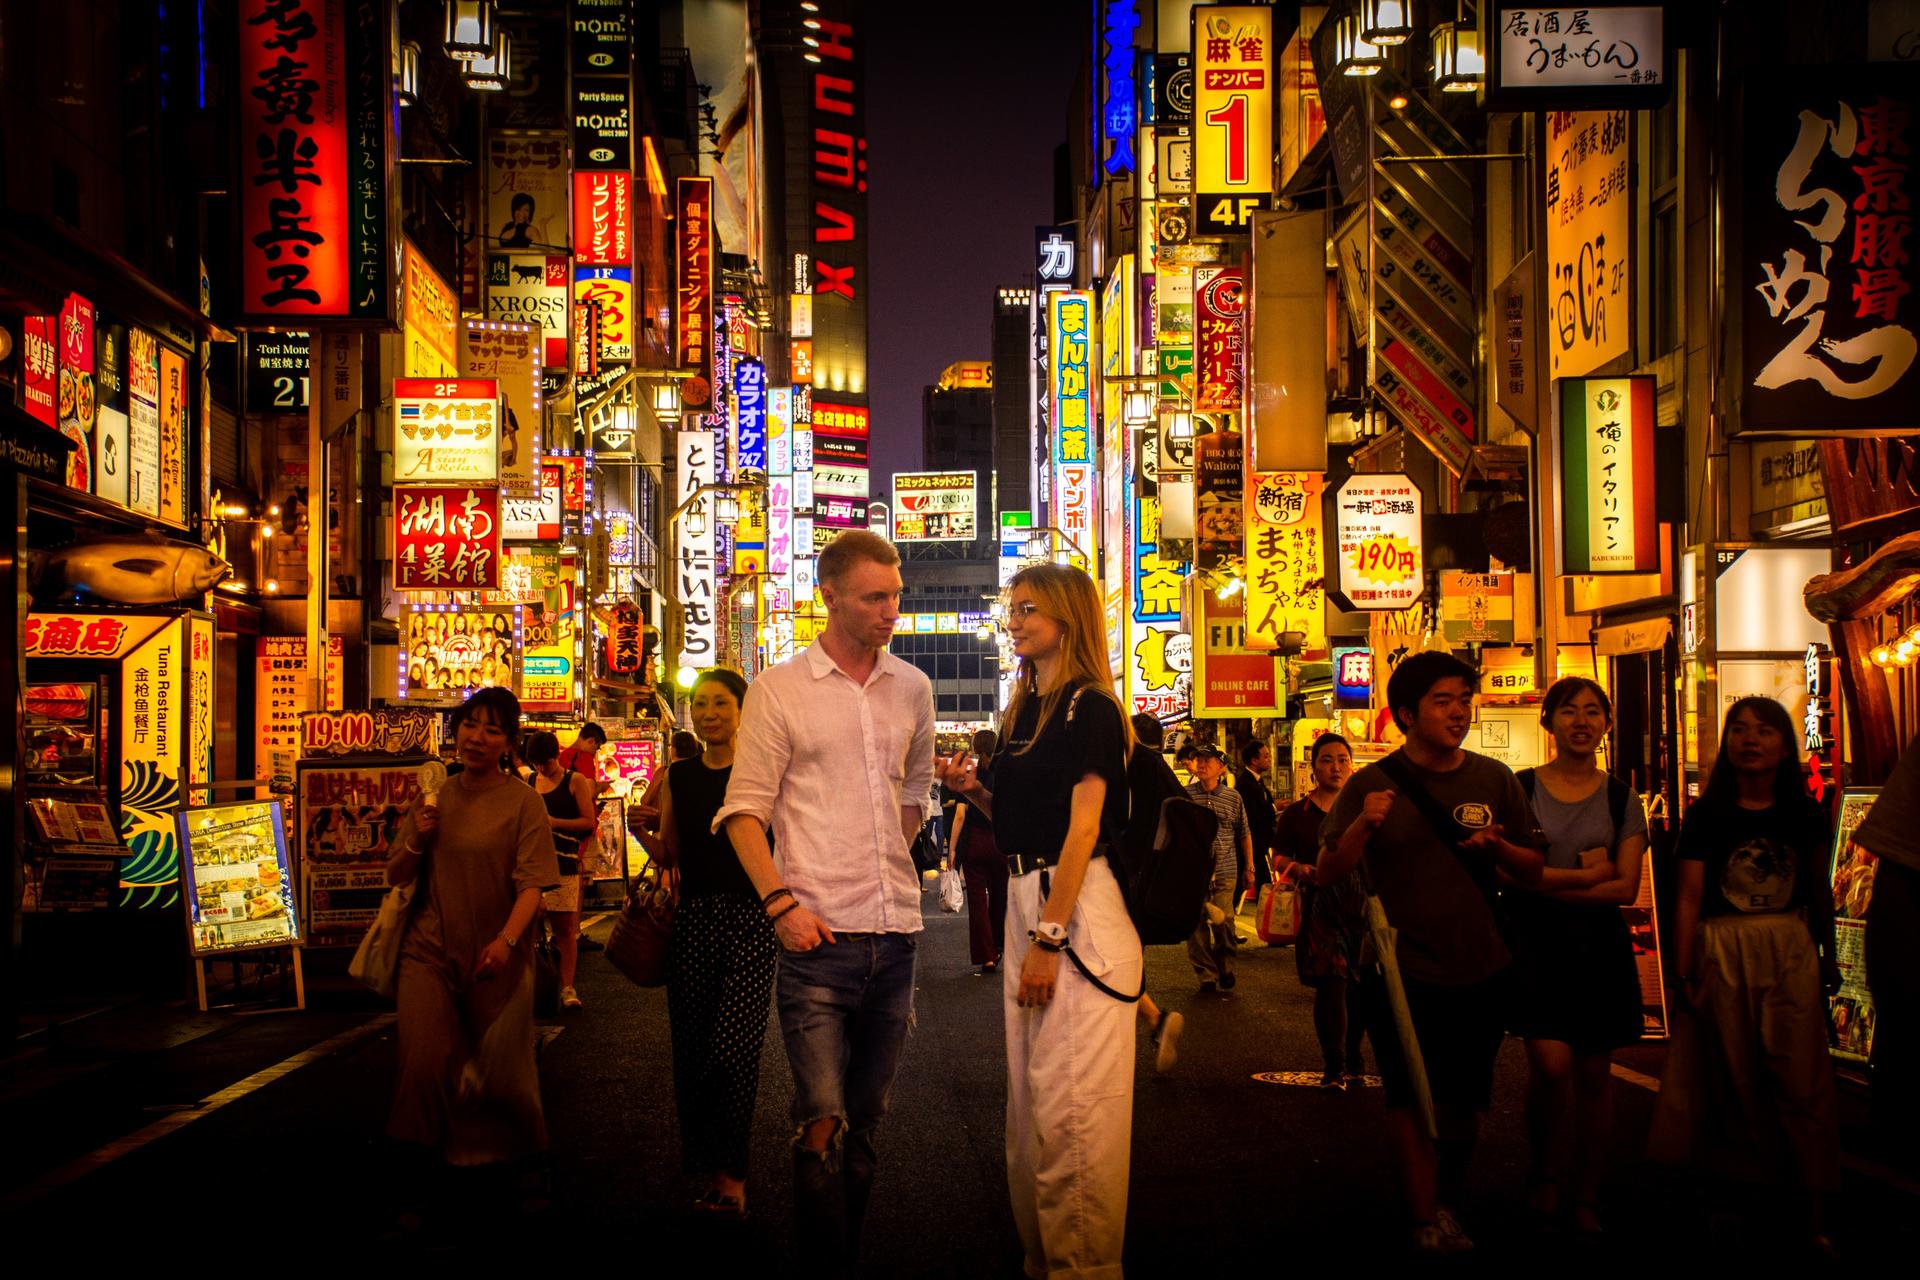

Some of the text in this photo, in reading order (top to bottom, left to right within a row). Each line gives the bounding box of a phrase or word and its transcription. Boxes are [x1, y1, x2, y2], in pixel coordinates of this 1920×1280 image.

[1503, 10, 1593, 37] 居酒屋
[1205, 37, 1264, 63] 麻雀
[1208, 72, 1262, 87] ナンバー
[1614, 69, 1658, 84] 一番街
[579, 92, 624, 102] Party Space
[1206, 94, 1249, 185] 1
[1548, 164, 1560, 215] 串
[592, 175, 610, 263] リフレッシュ
[614, 174, 626, 260] レンタルルーム ホステル
[1210, 198, 1259, 226] 4F
[1851, 96, 1914, 322] 東京豚骨
[593, 268, 614, 279] 1F
[686, 202, 703, 363] 個室ダイニング居酒屋
[1197, 270, 1214, 281] 3F
[491, 296, 565, 313] XROSS
[469, 345, 529, 359] マッサージ
[603, 345, 630, 358] 天神
[1210, 319, 1227, 398] カリーナ
[469, 362, 486, 372] 2F
[434, 384, 457, 396] 2F
[1060, 301, 1088, 461] まんが喫茶
[1377, 371, 1400, 393] B1
[422, 402, 492, 421] タイ古式
[739, 362, 761, 450] カラオケ
[812, 411, 867, 430] 全店営業中
[400, 423, 492, 441] マッサージ
[738, 452, 761, 466] 747
[803, 431, 812, 466] カラオケ
[1205, 449, 1225, 458] BBQ
[436, 463, 481, 473] Relax
[1595, 420, 1622, 550] 俺のイタリアン
[1065, 468, 1085, 550] マンボー
[1258, 485, 1304, 512] 新宿
[1342, 499, 1415, 515] 一軒め酒場
[401, 488, 493, 542] 湖南
[501, 507, 548, 522] ASA
[1273, 509, 1289, 523] の
[1358, 542, 1415, 572] 190円
[1591, 554, 1634, 562] KABUKICHO
[1717, 552, 1735, 564] 5F
[1255, 526, 1291, 636] まっちゃん
[1211, 625, 1244, 647] FI
[1211, 680, 1270, 691] ONLINE CAFE
[133, 667, 150, 744] 金枪鱼餐厅
[157, 645, 171, 757] Tuna Restaurant
[304, 714, 373, 748] 19:00
[374, 712, 432, 749] オープン
